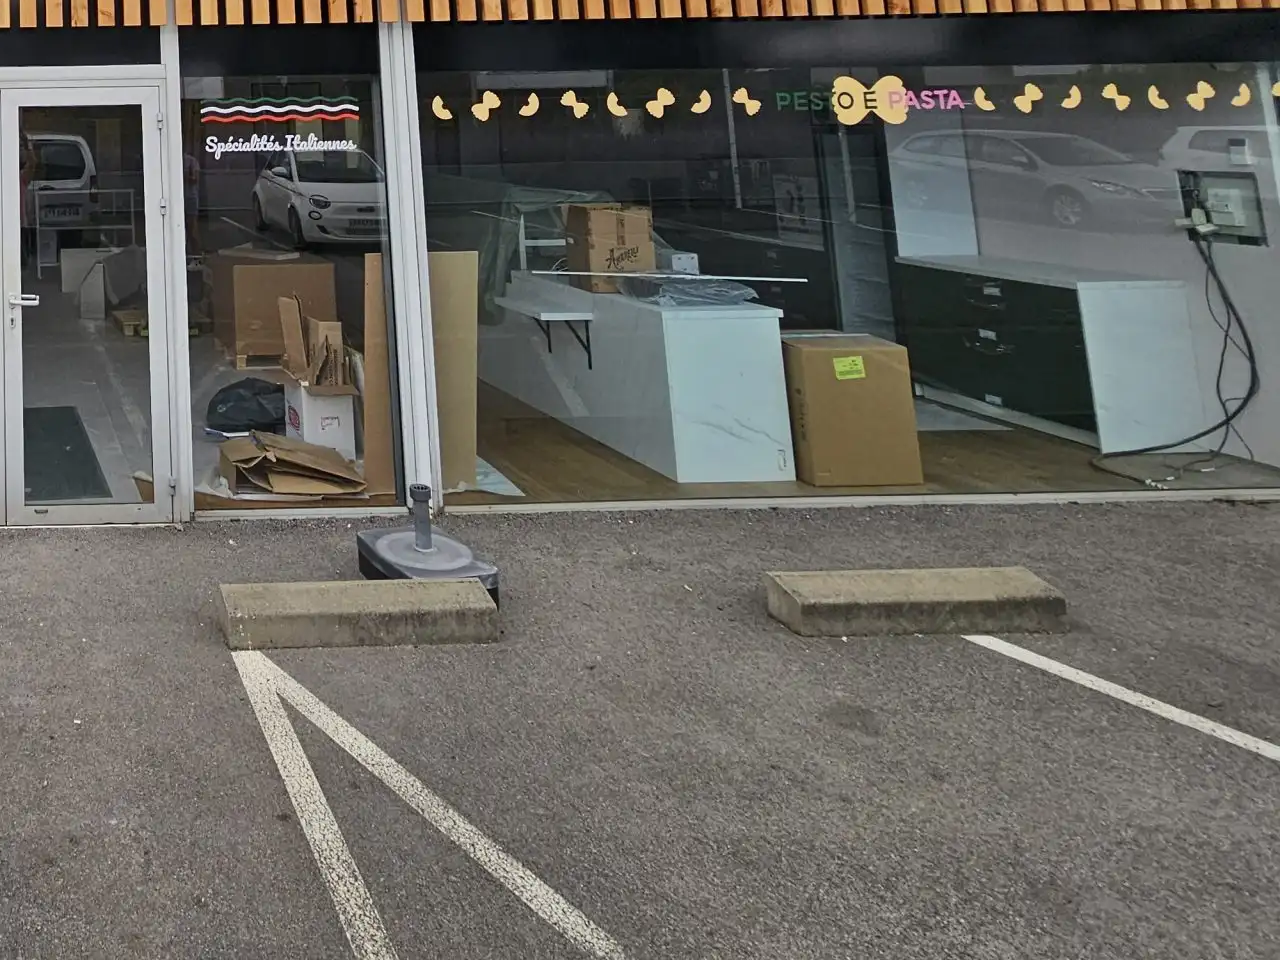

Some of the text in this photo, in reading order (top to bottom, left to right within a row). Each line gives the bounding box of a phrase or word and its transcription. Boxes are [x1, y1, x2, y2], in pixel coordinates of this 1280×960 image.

[775, 89, 966, 111] PESTO E PASTA
[205, 132, 357, 160] Spécialités Italiennes
